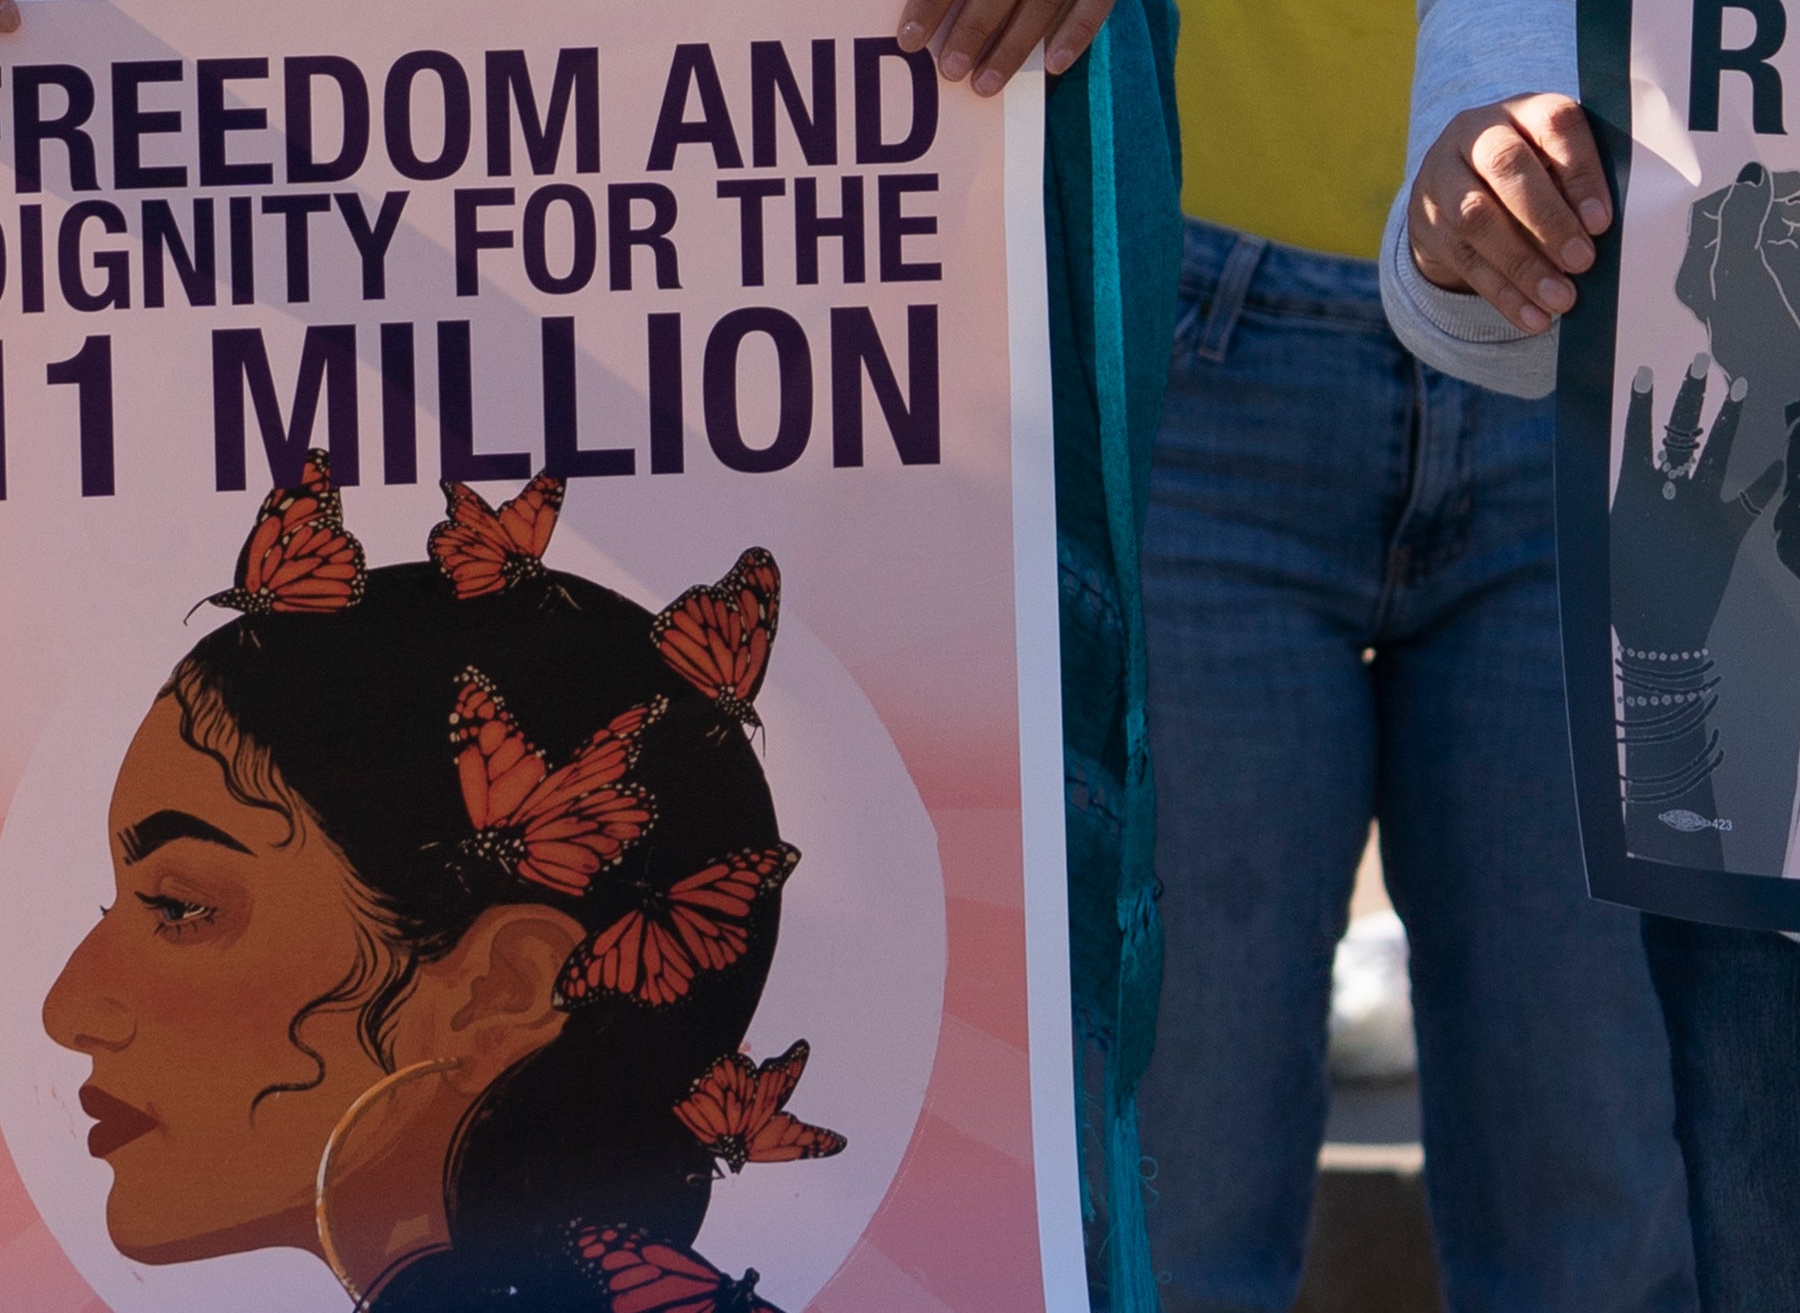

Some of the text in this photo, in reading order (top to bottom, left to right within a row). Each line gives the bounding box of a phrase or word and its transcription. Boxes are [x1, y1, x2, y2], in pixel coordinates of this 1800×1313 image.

[645, 35, 941, 173] AND
[454, 181, 682, 298] FOR
[716, 172, 944, 289] THE
[211, 303, 942, 494] MILLION
[1711, 818, 1733, 832] 423
